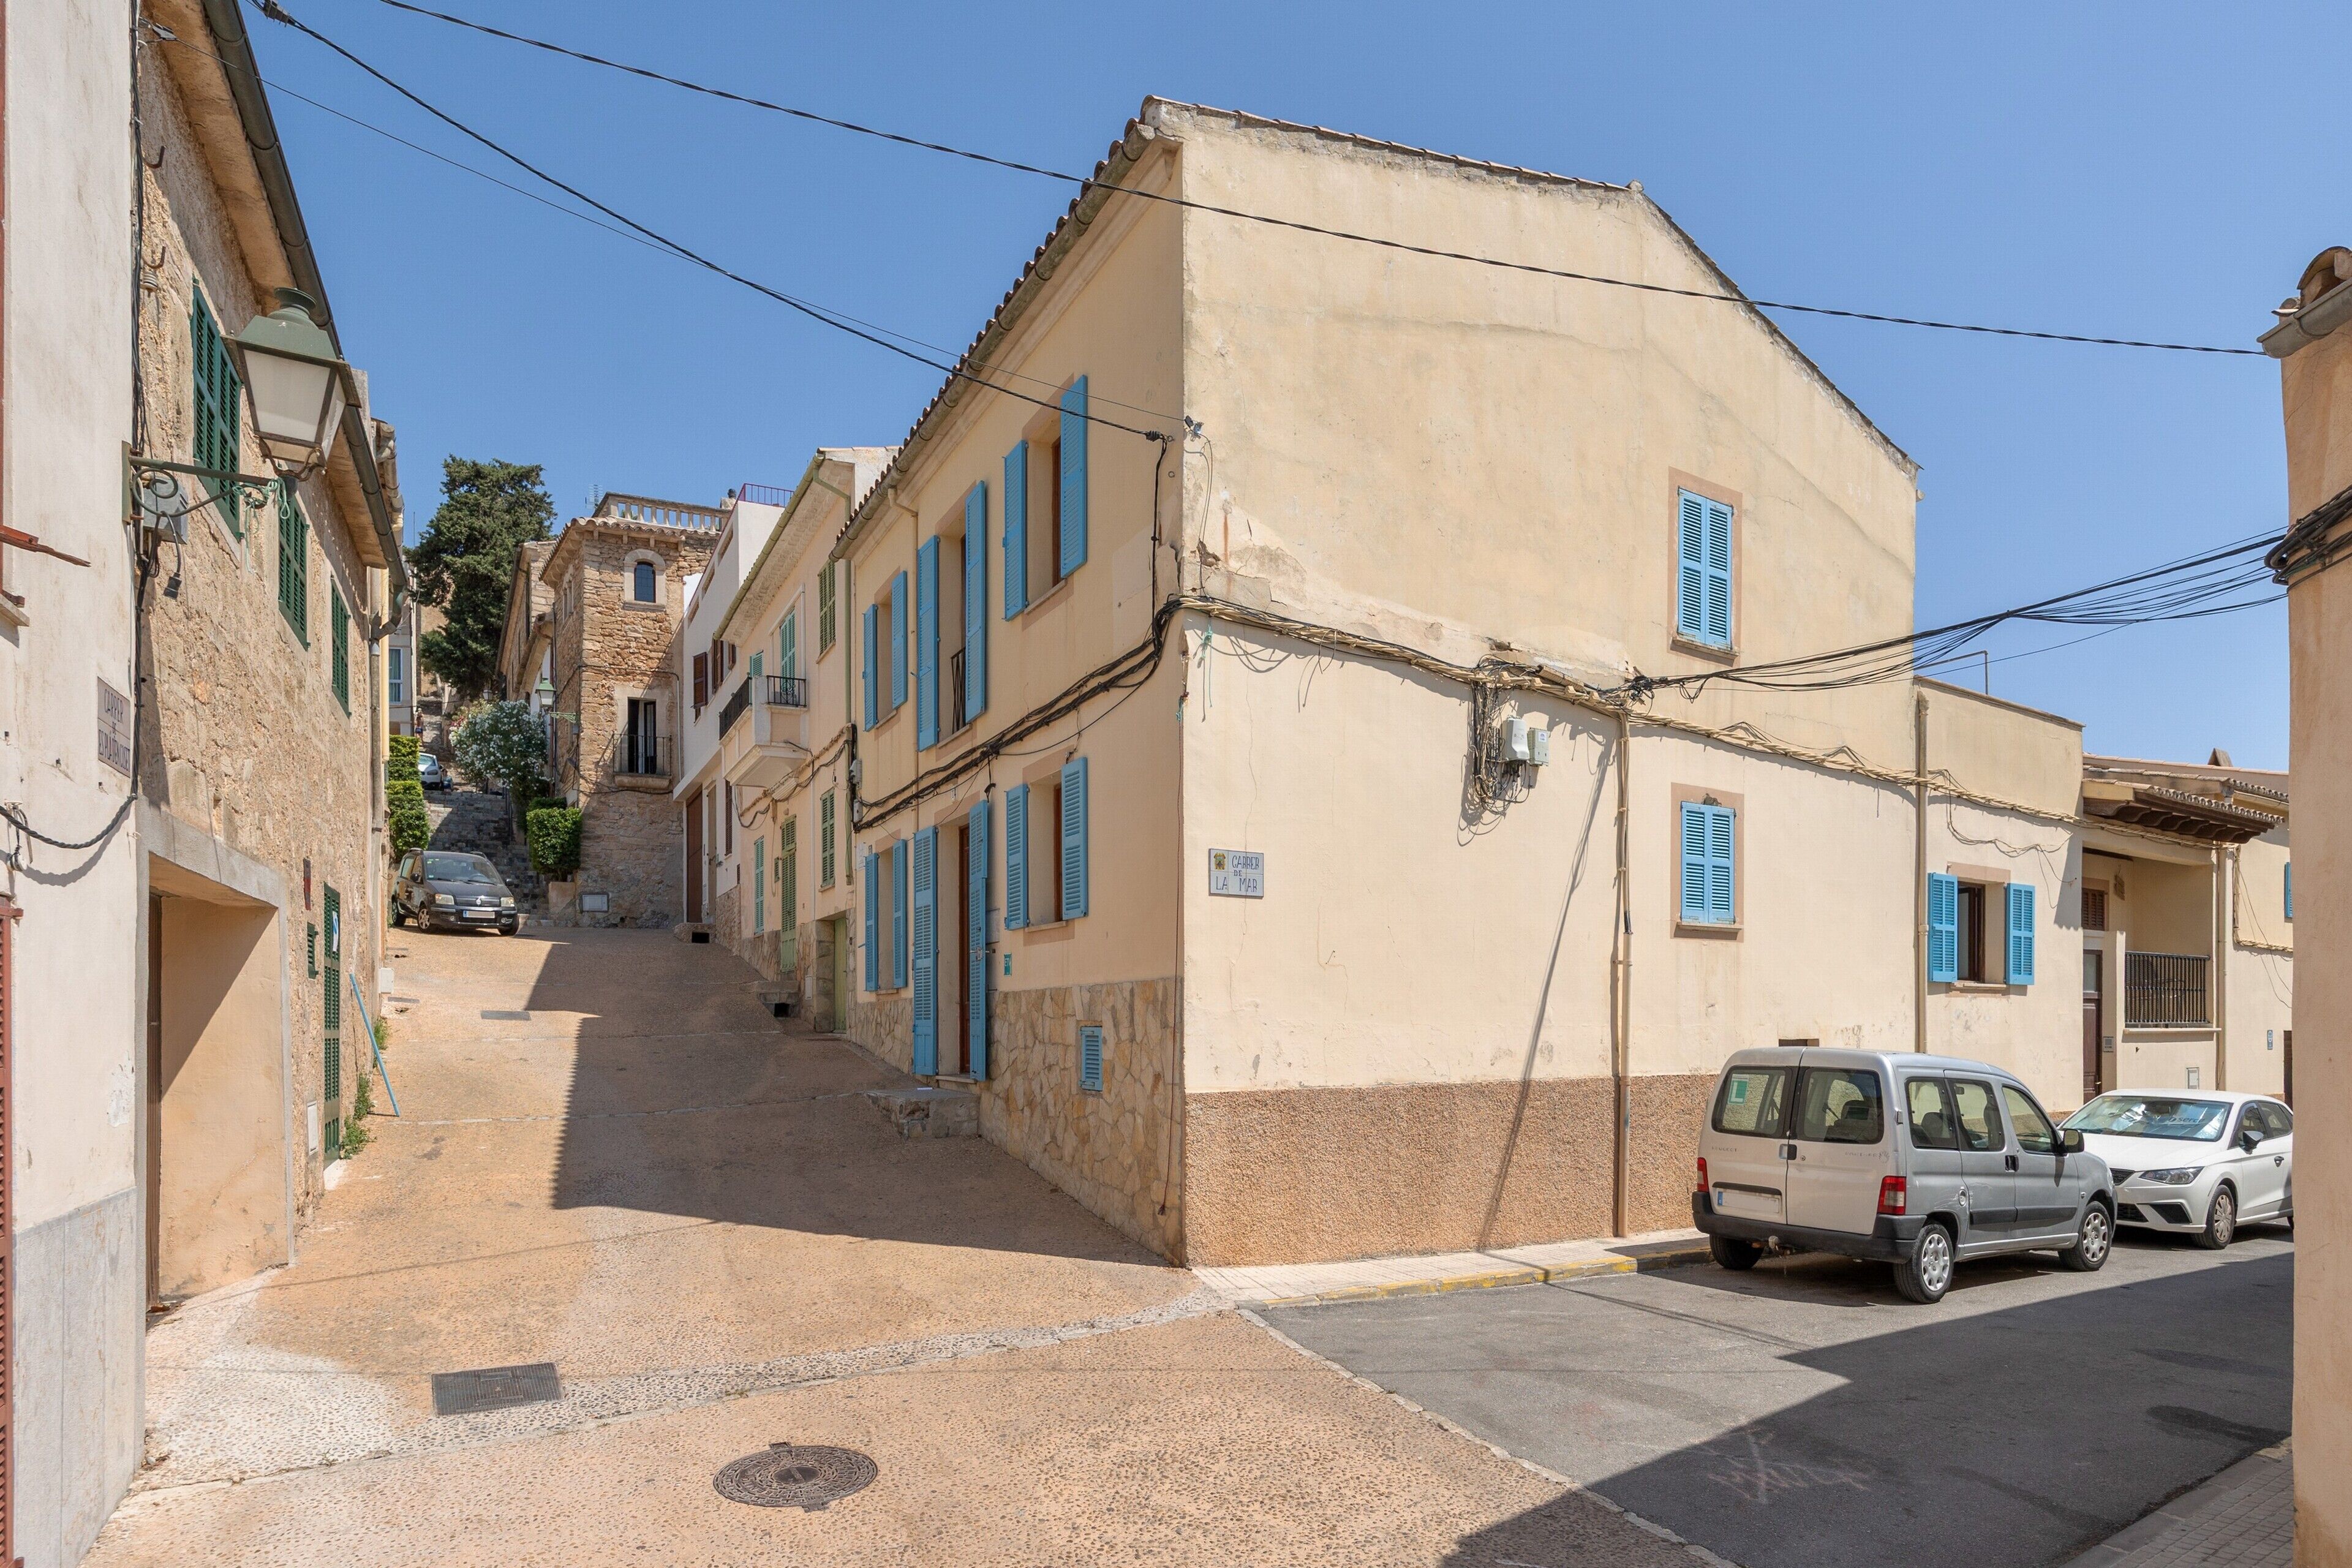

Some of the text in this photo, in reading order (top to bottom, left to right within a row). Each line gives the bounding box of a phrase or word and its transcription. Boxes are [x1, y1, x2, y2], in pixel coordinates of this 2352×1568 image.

[104, 688, 124, 724] CARRER
[1232, 854, 1259, 870] CARRER
[1216, 876, 1257, 892] LA MAR
[1730, 1082, 1744, 1102] L
